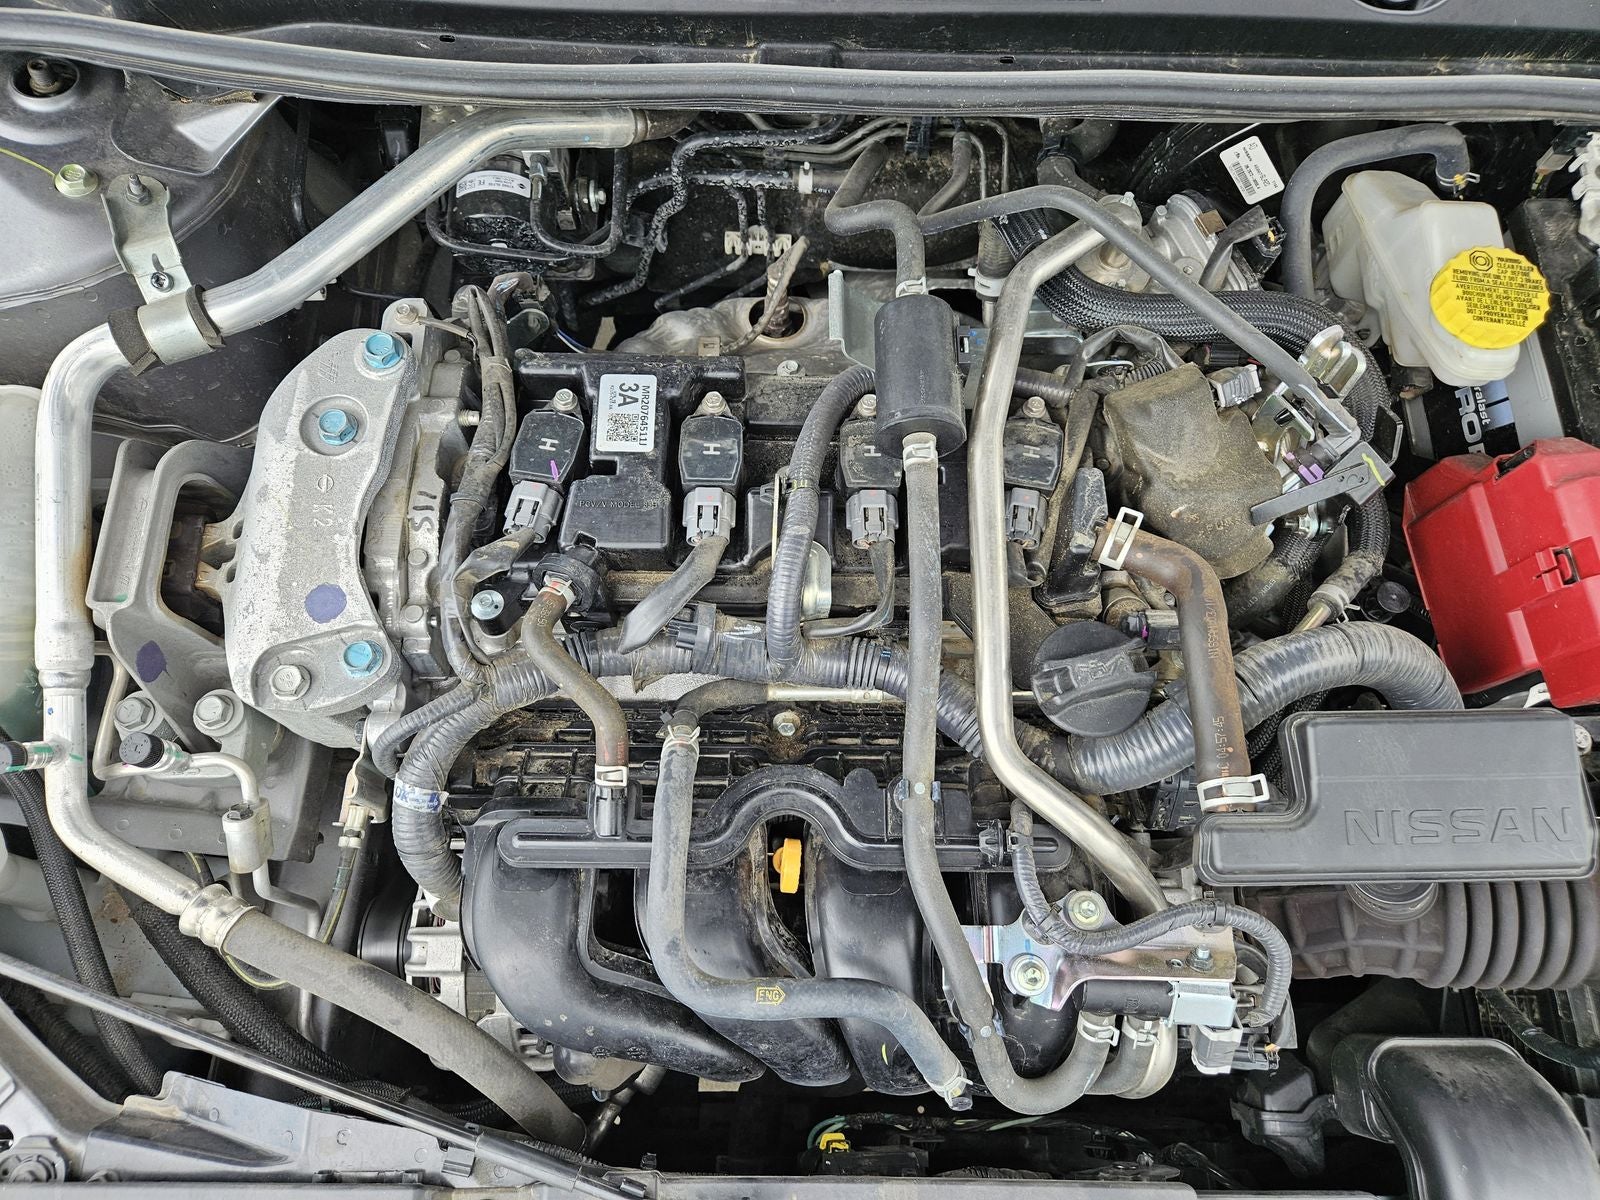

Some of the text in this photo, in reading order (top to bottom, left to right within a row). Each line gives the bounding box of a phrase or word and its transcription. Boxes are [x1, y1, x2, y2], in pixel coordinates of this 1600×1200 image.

[618, 382, 640, 408] 3A
[638, 385, 651, 446] MR20764511J
[1344, 806, 1573, 846] NISSAN
[759, 989, 779, 1001] ENG
